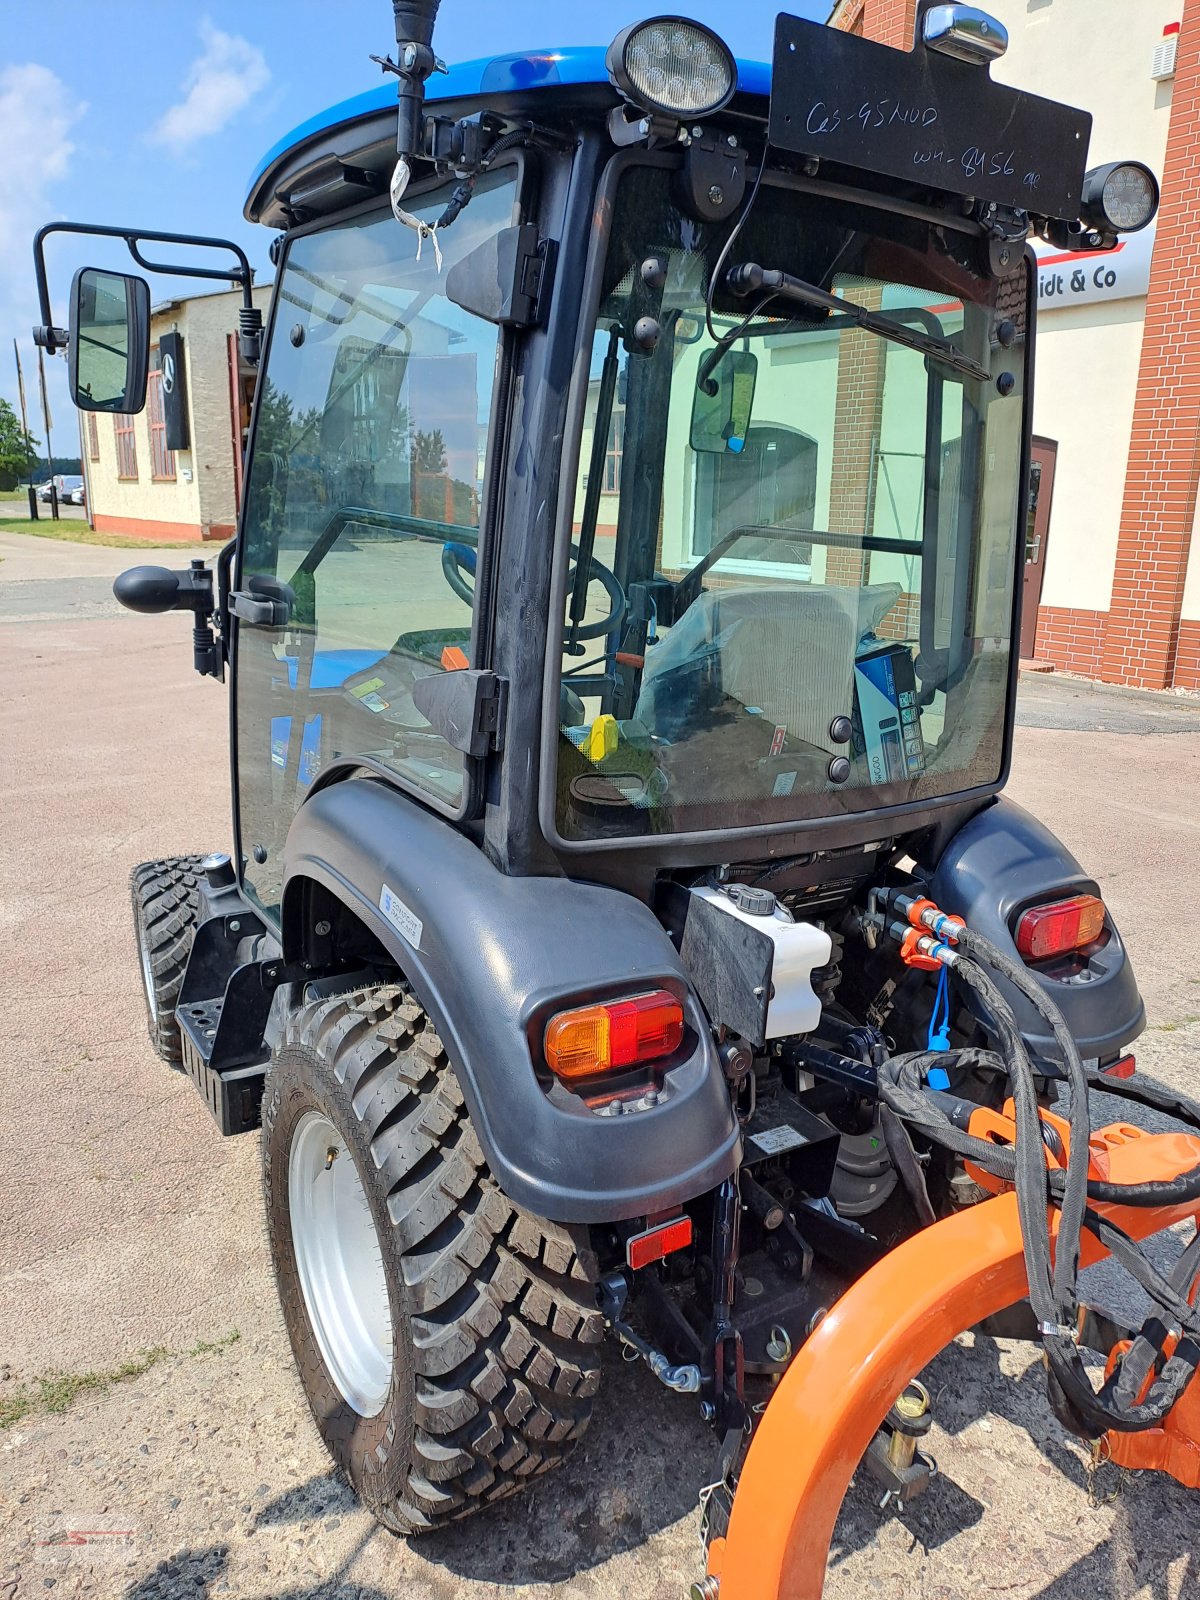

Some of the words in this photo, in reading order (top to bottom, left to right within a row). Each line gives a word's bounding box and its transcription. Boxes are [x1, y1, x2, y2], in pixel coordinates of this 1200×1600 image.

[1038, 273, 1063, 298] idt
[1070, 268, 1086, 293] &
[1093, 265, 1117, 289] Co
